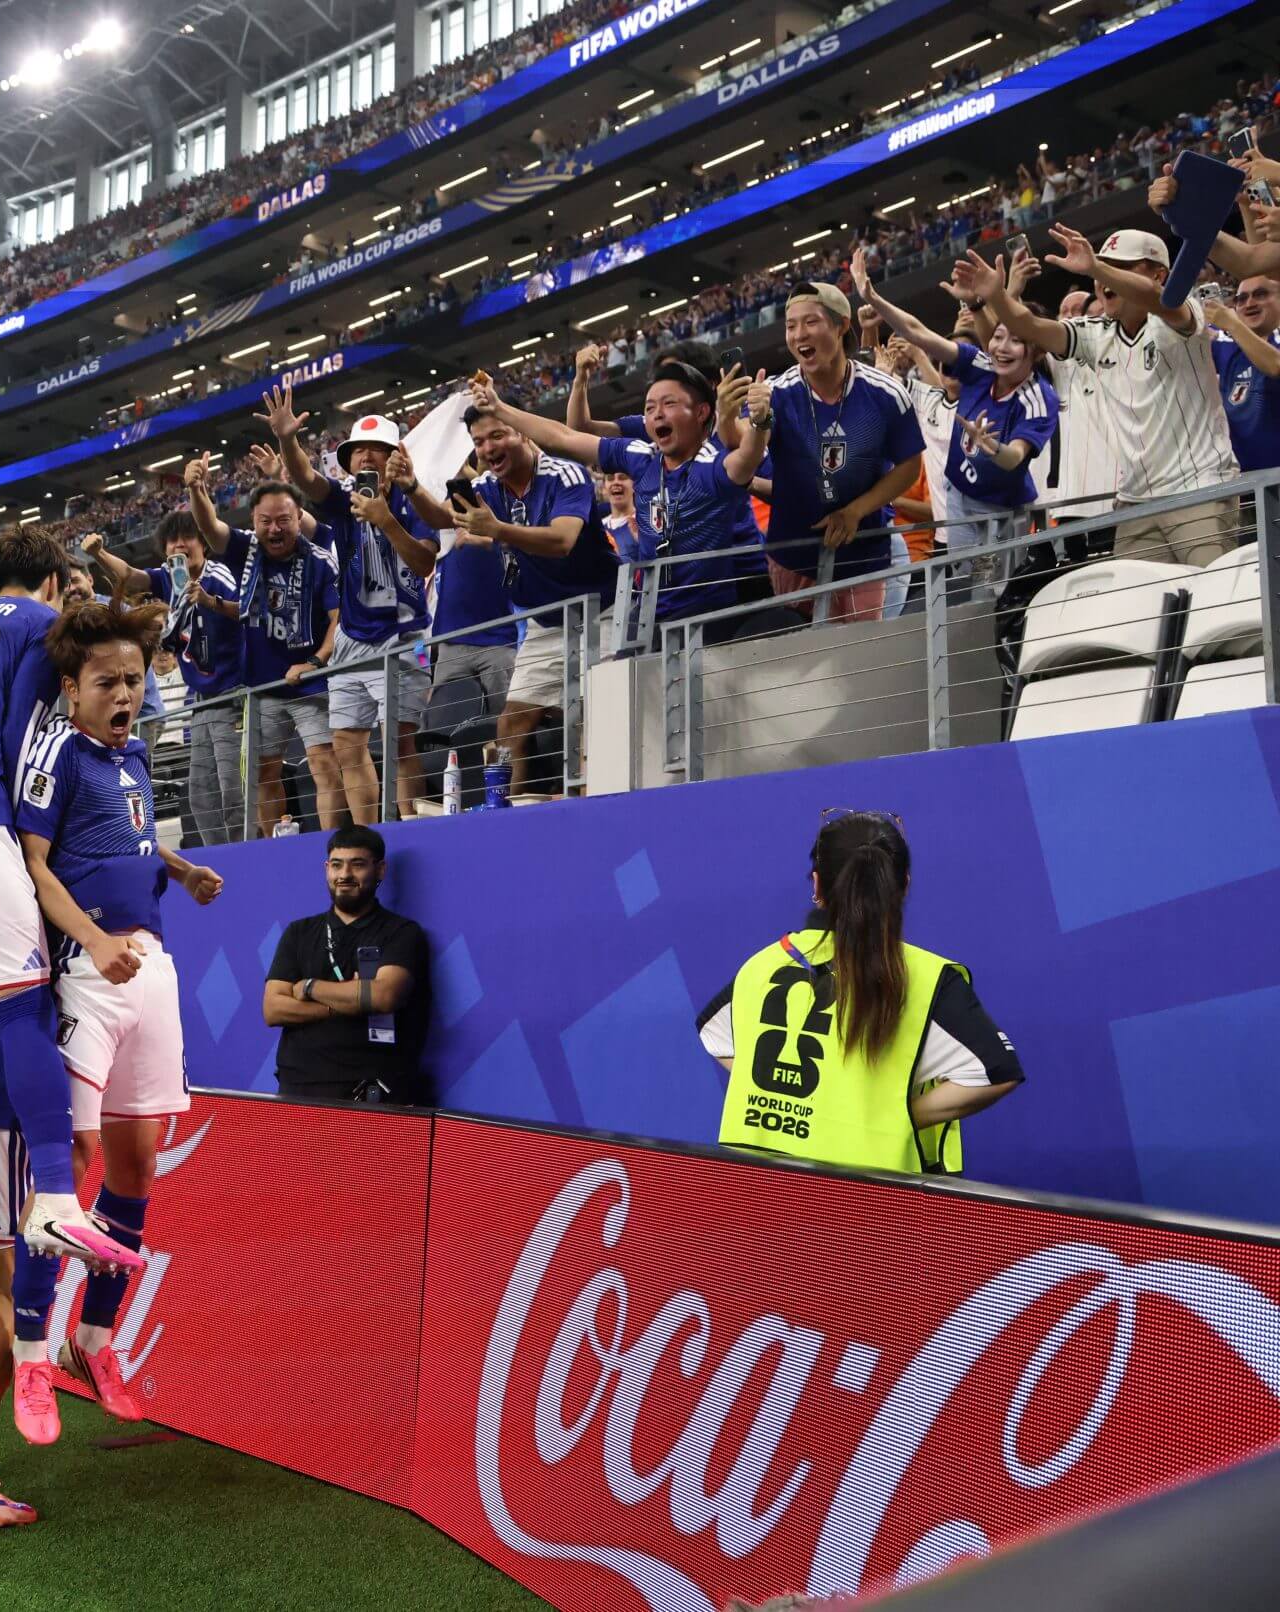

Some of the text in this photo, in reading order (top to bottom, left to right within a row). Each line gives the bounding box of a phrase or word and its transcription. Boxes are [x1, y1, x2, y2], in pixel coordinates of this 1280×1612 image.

[570, 0, 705, 67] FIFA WORL
[718, 35, 840, 105] DALLAS
[887, 92, 996, 152] #FIFAWorldCup
[258, 174, 326, 222] DALLAS
[289, 218, 442, 295] FIFA WORLD CUP 2026
[36, 360, 100, 394] DALLAS
[282, 352, 344, 389] DALLAS
[773, 1066, 803, 1087] FIFA
[744, 1108, 811, 1140] 2026
[747, 1094, 814, 1118] WORLD CUP
